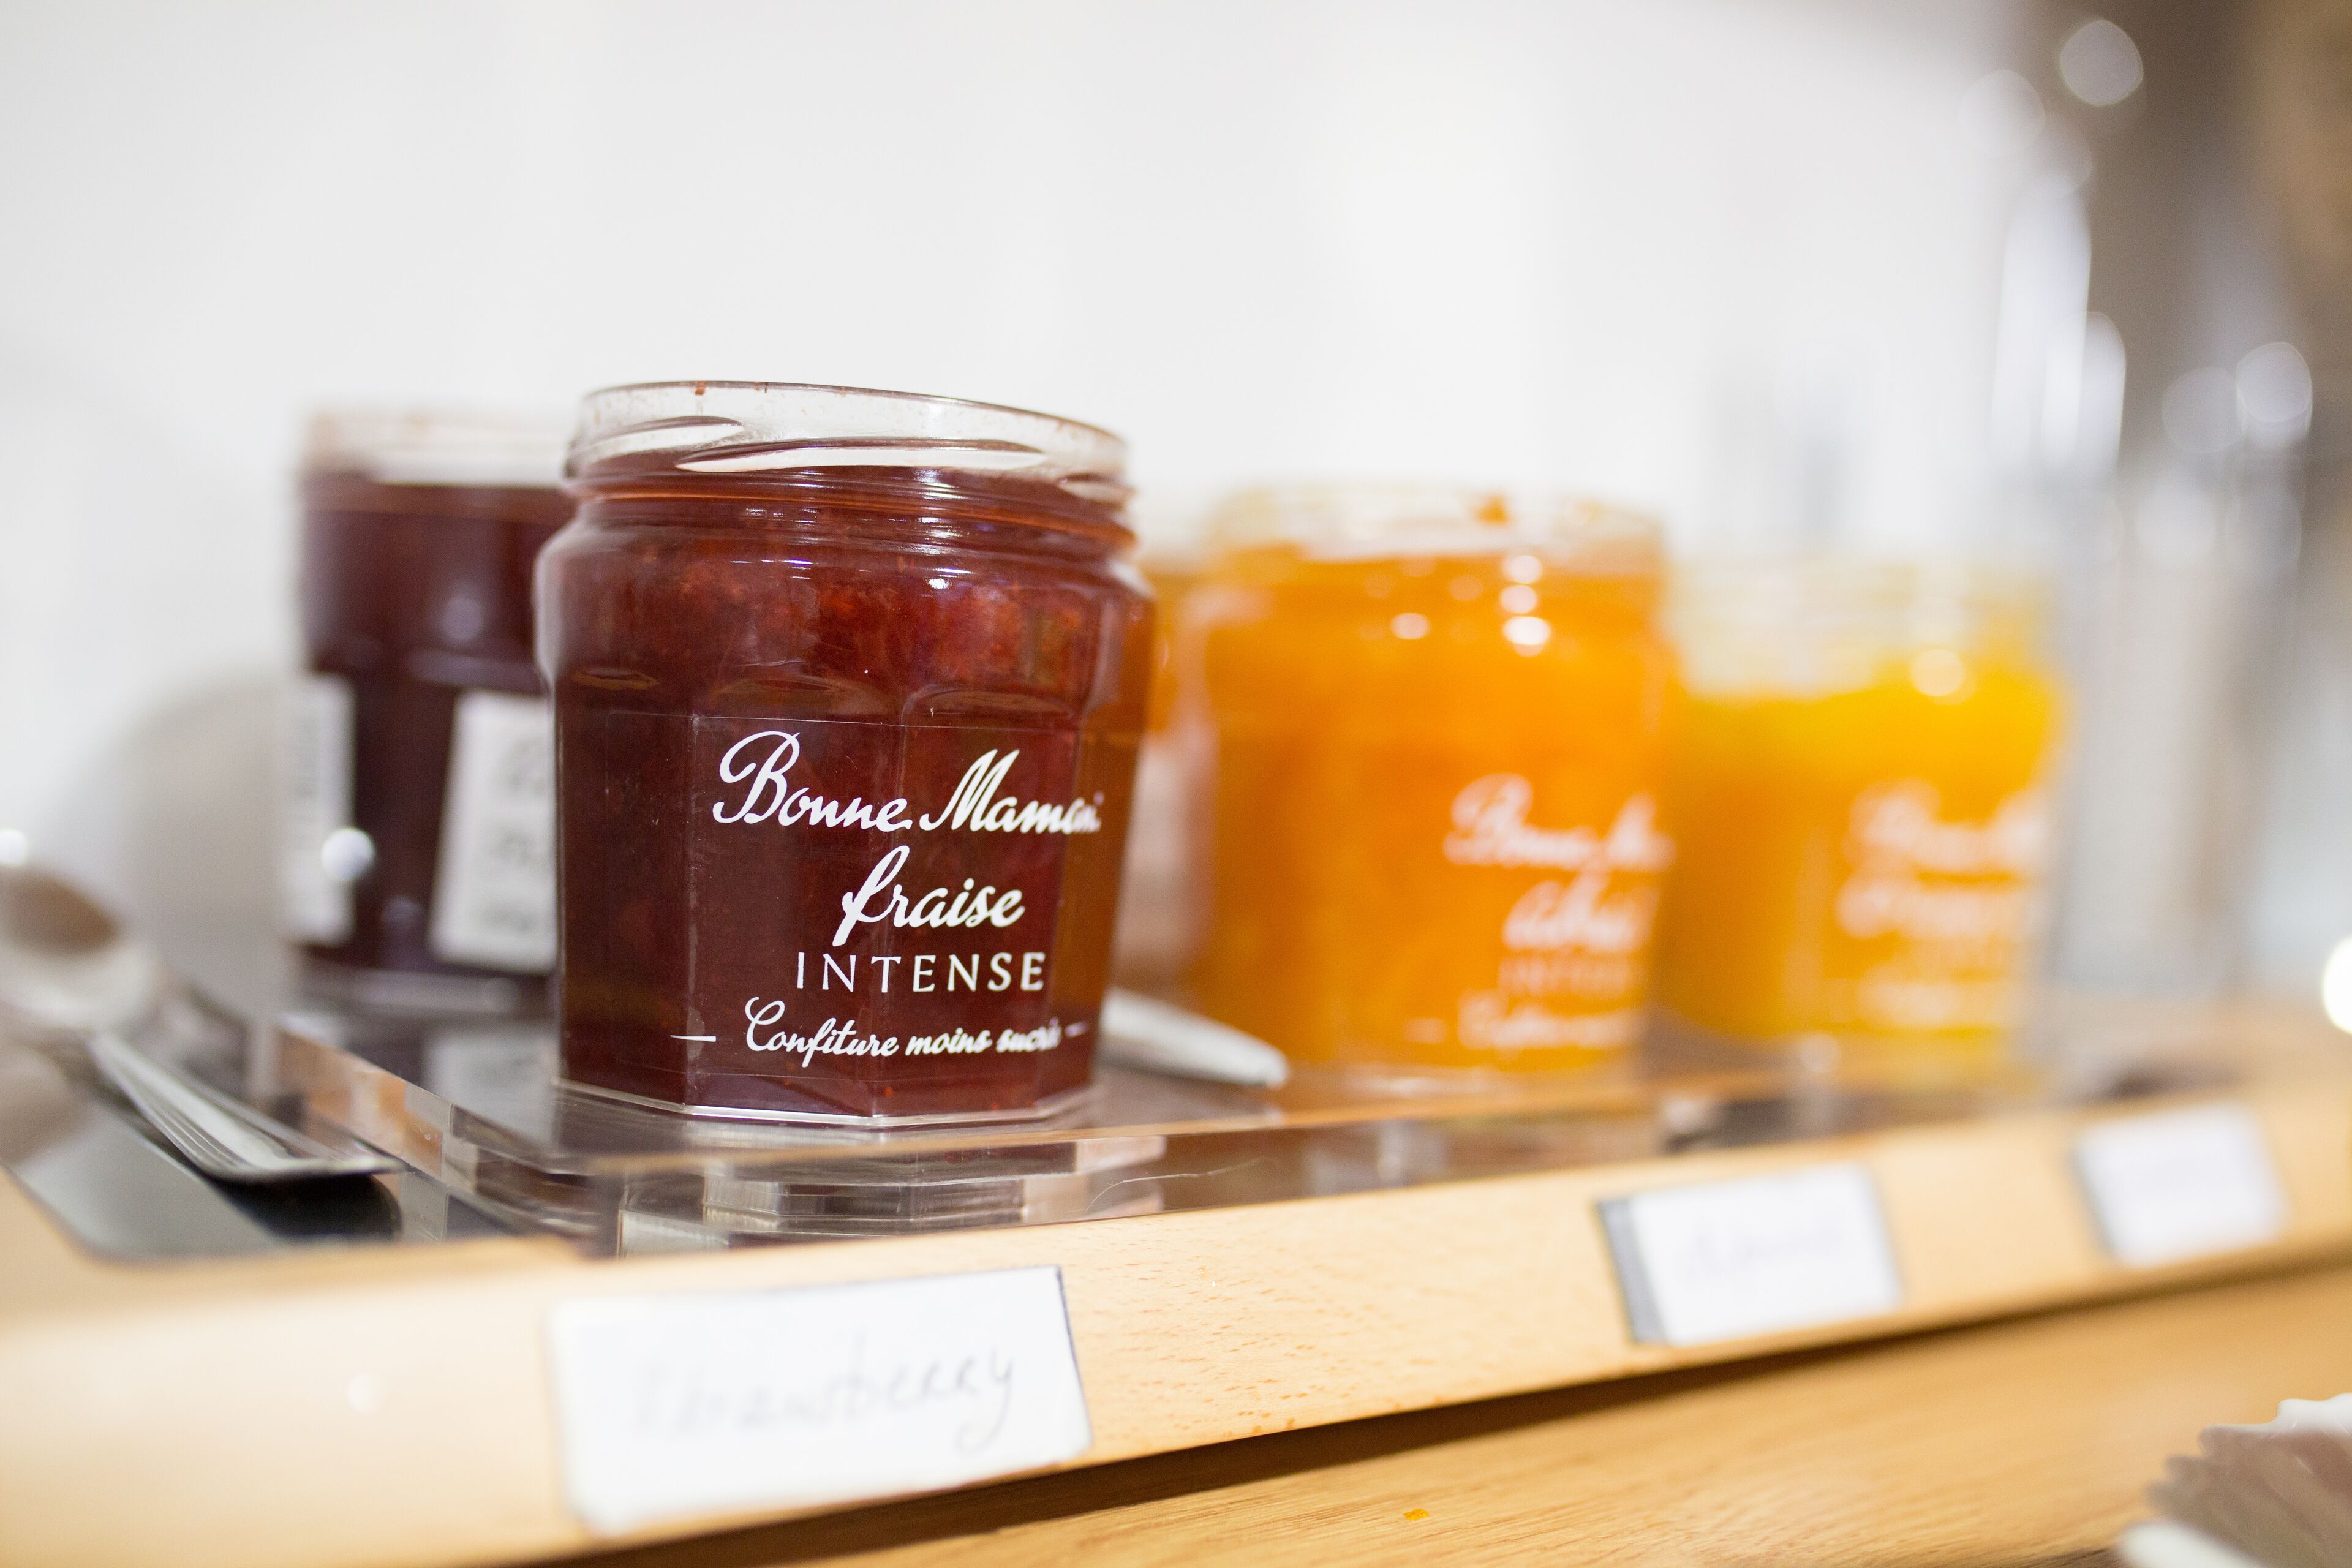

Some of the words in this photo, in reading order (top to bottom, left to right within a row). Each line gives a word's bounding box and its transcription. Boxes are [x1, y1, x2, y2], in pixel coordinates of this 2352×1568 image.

[712, 730, 913, 832] Bonne
[831, 845, 1026, 947] fraise
[796, 951, 1046, 993] INTENSE
[744, 995, 900, 1068] Confiture
[904, 1027, 993, 1056] moins
